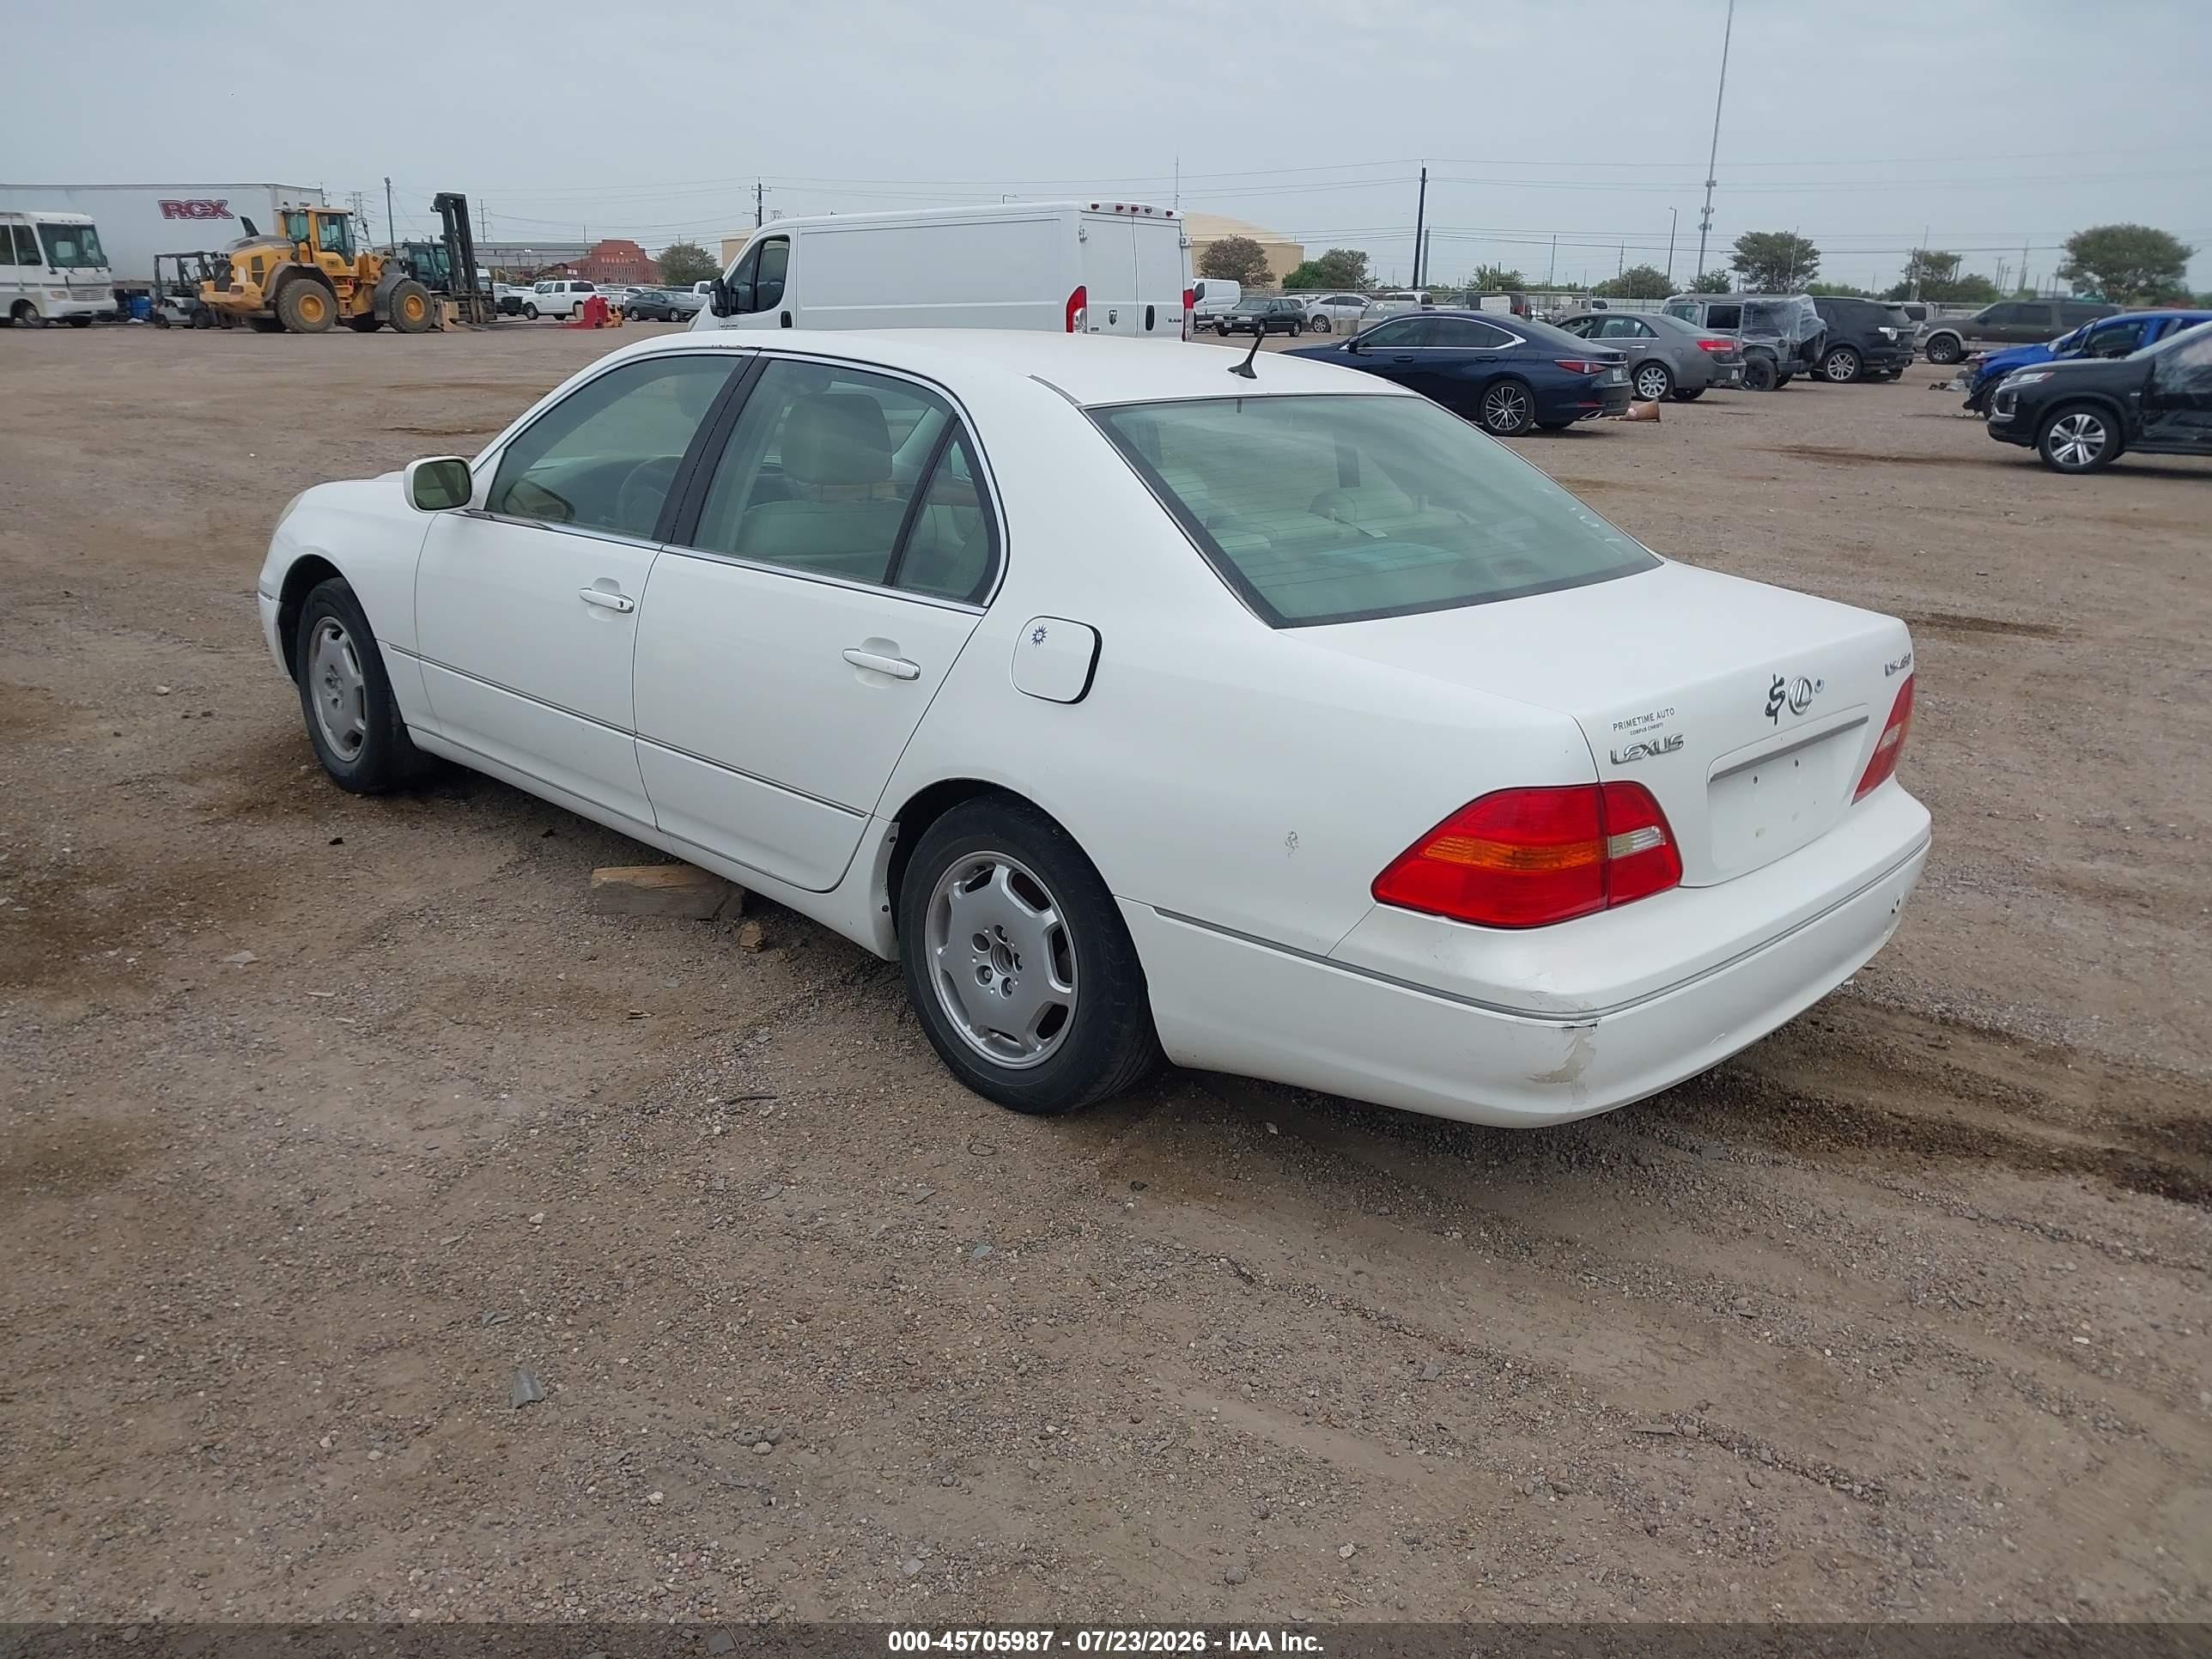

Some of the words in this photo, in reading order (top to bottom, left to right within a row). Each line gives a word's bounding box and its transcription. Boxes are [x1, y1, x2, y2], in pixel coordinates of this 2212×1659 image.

[1613, 713, 1656, 732] PRIMETIME
[1656, 707, 1675, 720] AUTO
[1630, 726, 1647, 736] CORPUS
[1610, 734, 1684, 765] LEXUS
